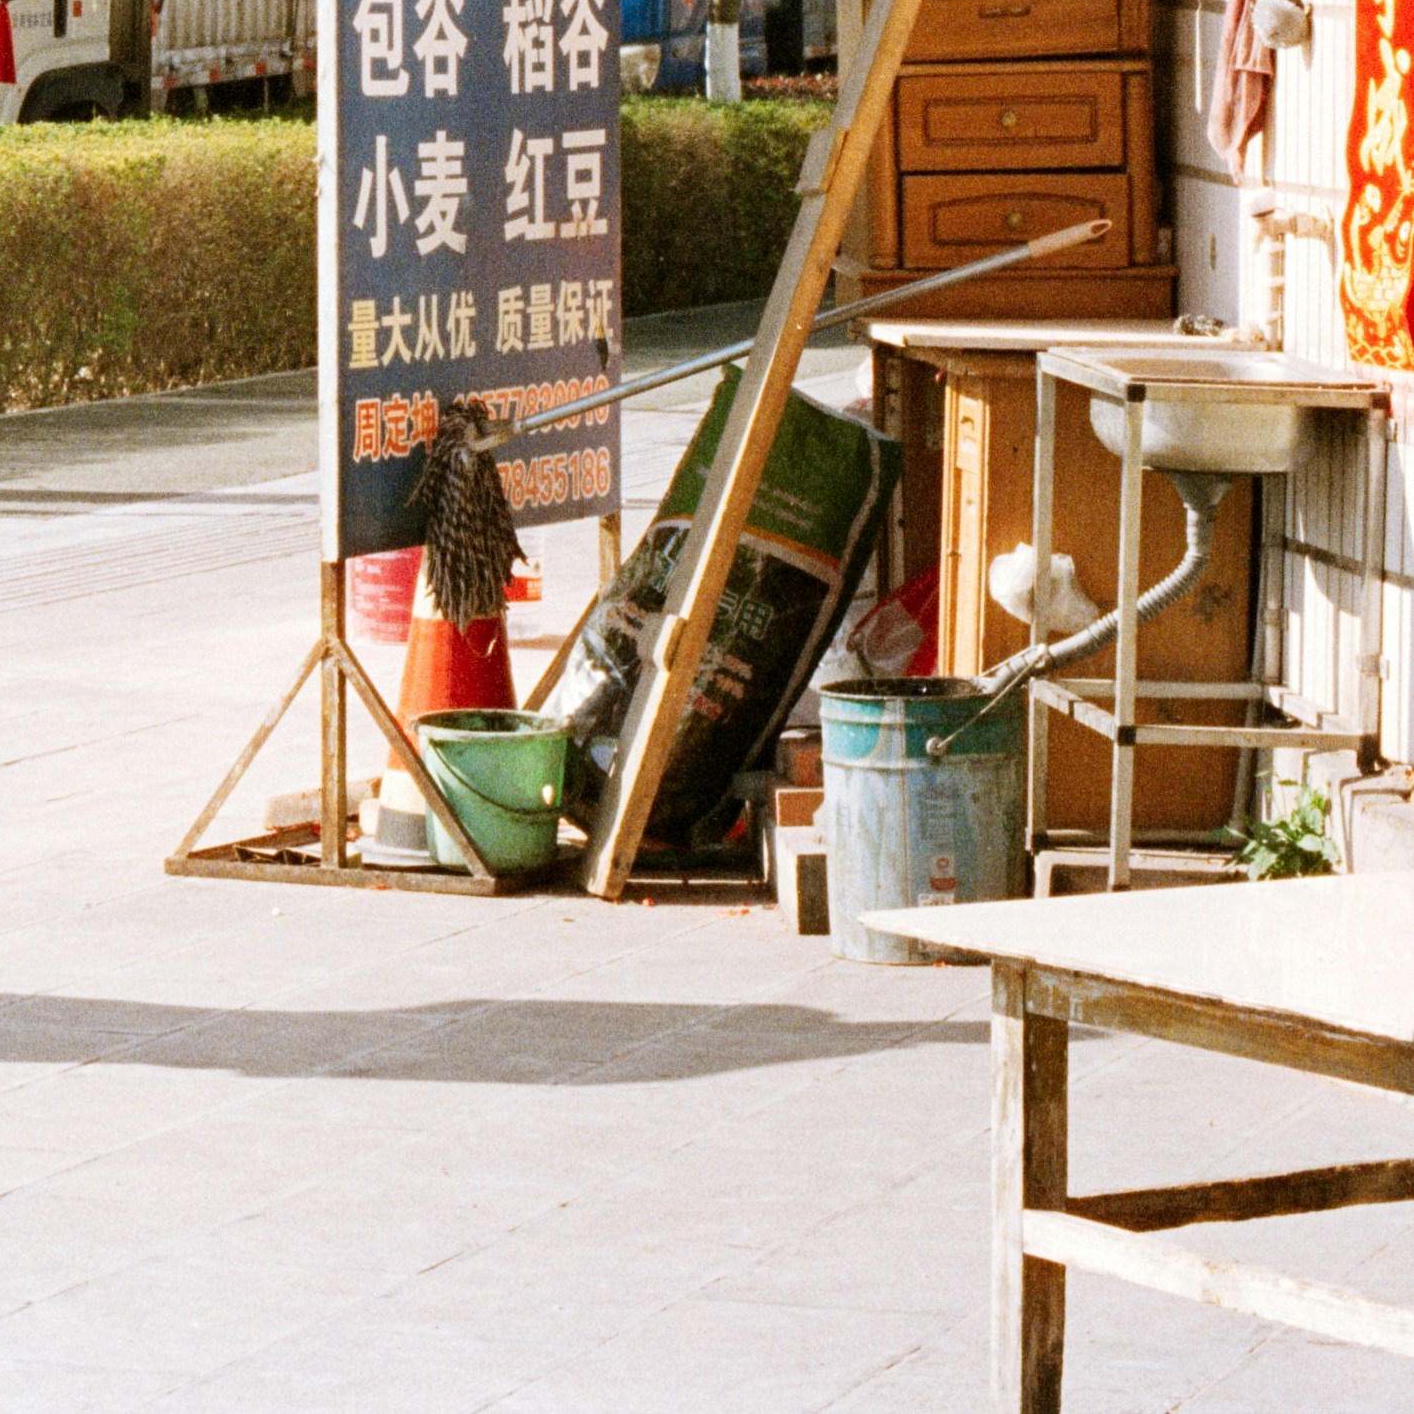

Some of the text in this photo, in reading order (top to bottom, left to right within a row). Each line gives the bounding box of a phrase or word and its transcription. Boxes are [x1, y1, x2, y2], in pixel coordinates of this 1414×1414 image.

[353, 127, 610, 259] 小麦 红豆
[348, 279, 615, 369] 量大从优 质量保证
[353, 390, 439, 464] 周定坤
